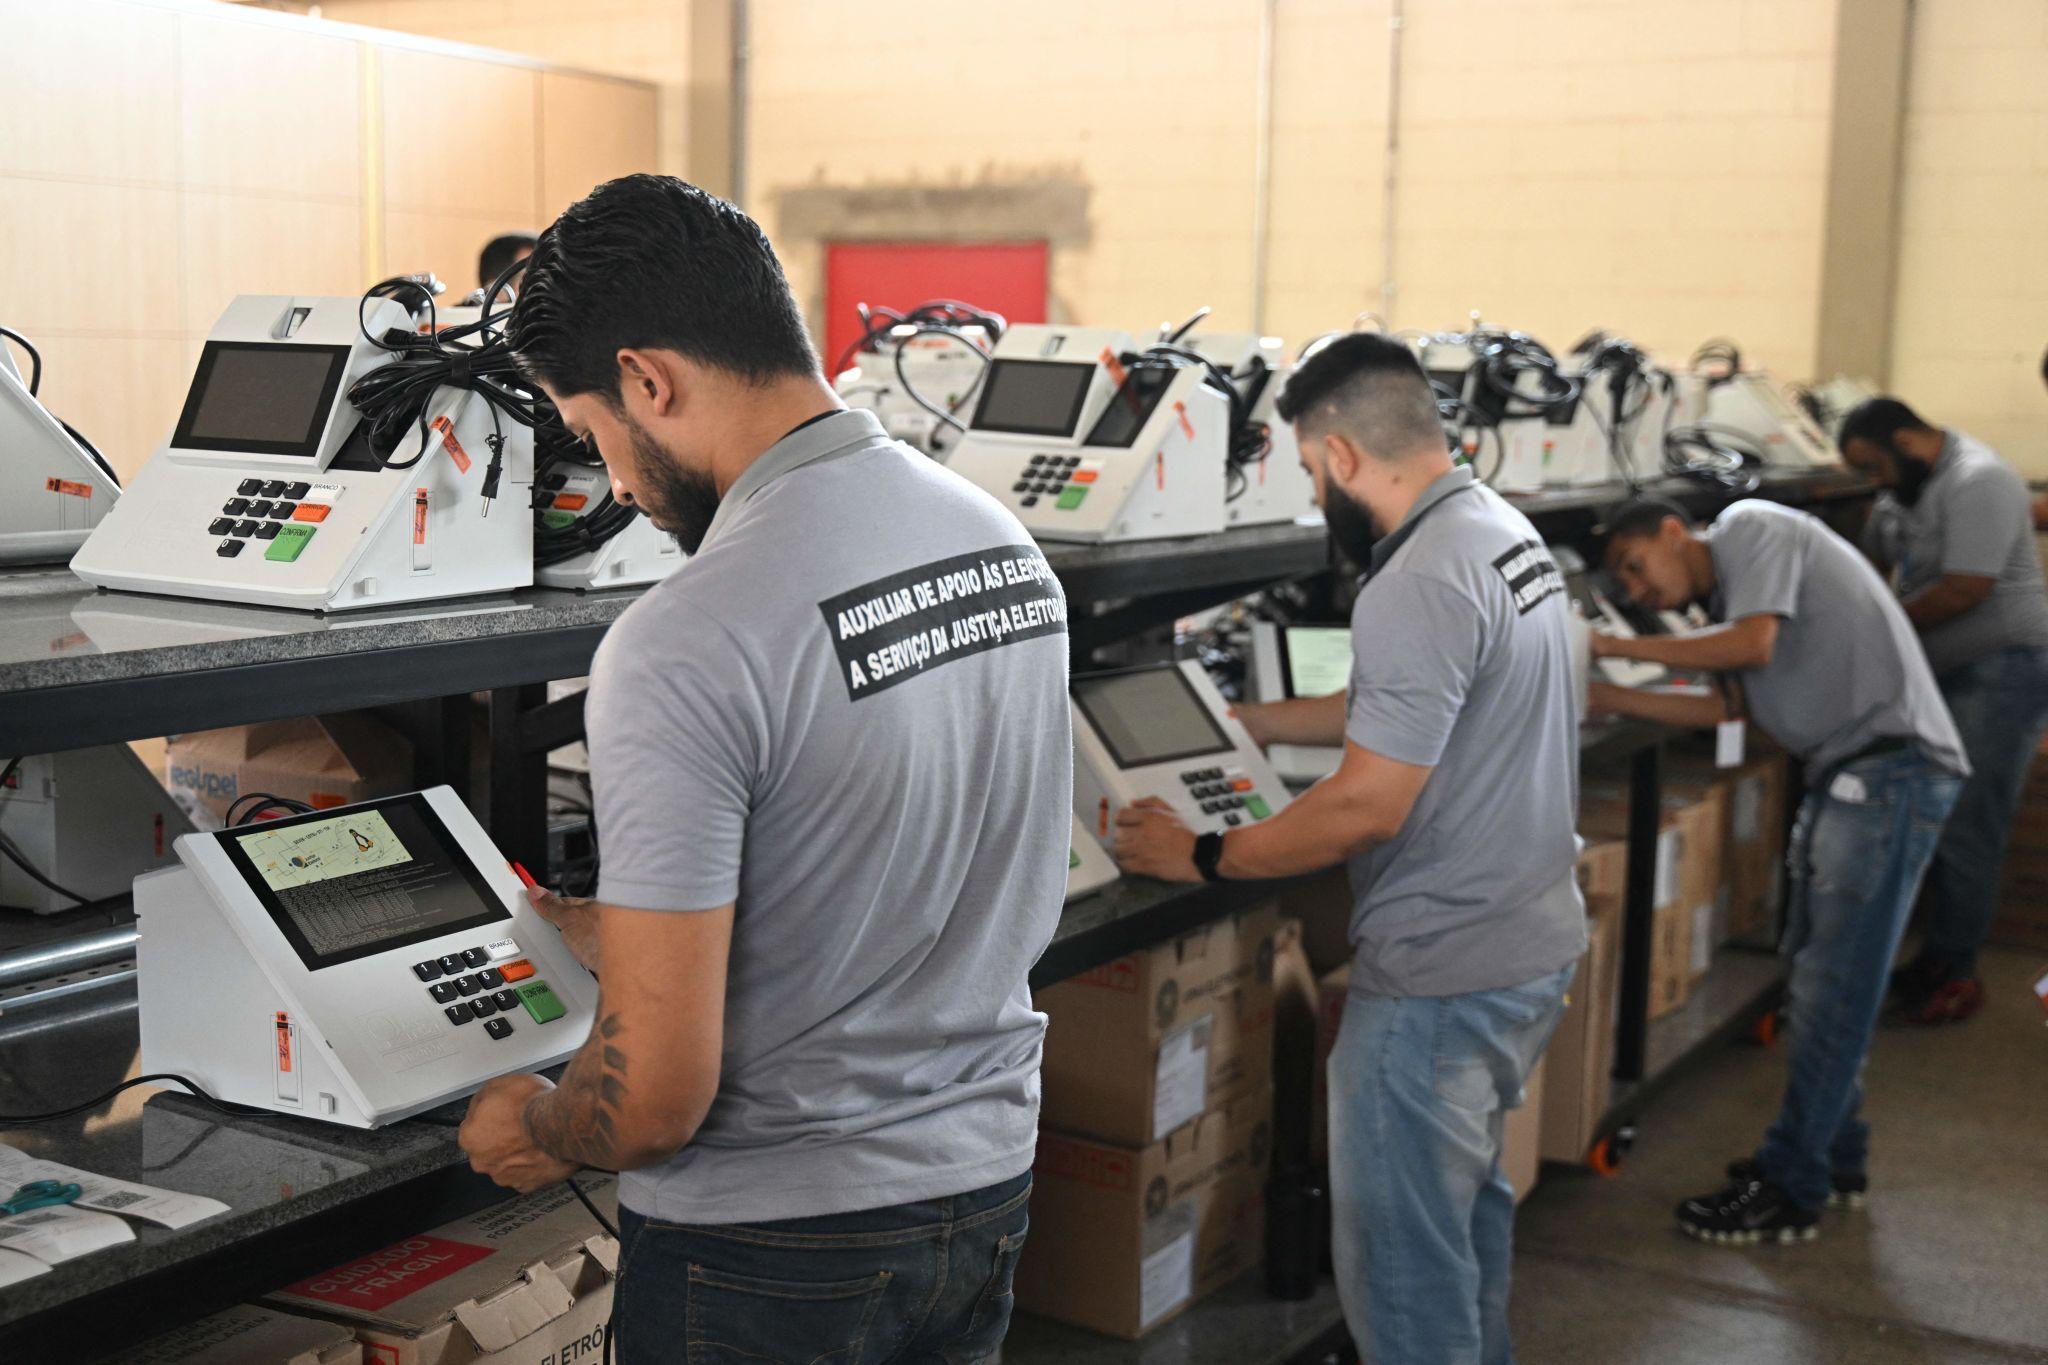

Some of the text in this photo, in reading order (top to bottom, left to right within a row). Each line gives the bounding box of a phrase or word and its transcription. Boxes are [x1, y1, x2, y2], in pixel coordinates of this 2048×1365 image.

[264, 480, 272, 488] 2
[236, 520, 243, 528] 8
[837, 553, 1056, 640] AUXILIAR DE APOIO ÀS ELEIÇÕE
[850, 597, 1067, 690] A SERVIÇO DA JUSTIÇA ELEITOR
[420, 937, 513, 972] 1 2 3 BRANCO
[436, 985, 444, 994] 4
[459, 978, 468, 987] 5
[482, 971, 490, 980] 6
[451, 984, 551, 1016] 7 8 9 CONFIRMA
[490, 1021, 499, 1030] 0
[309, 1239, 431, 1293] CUIDADO
